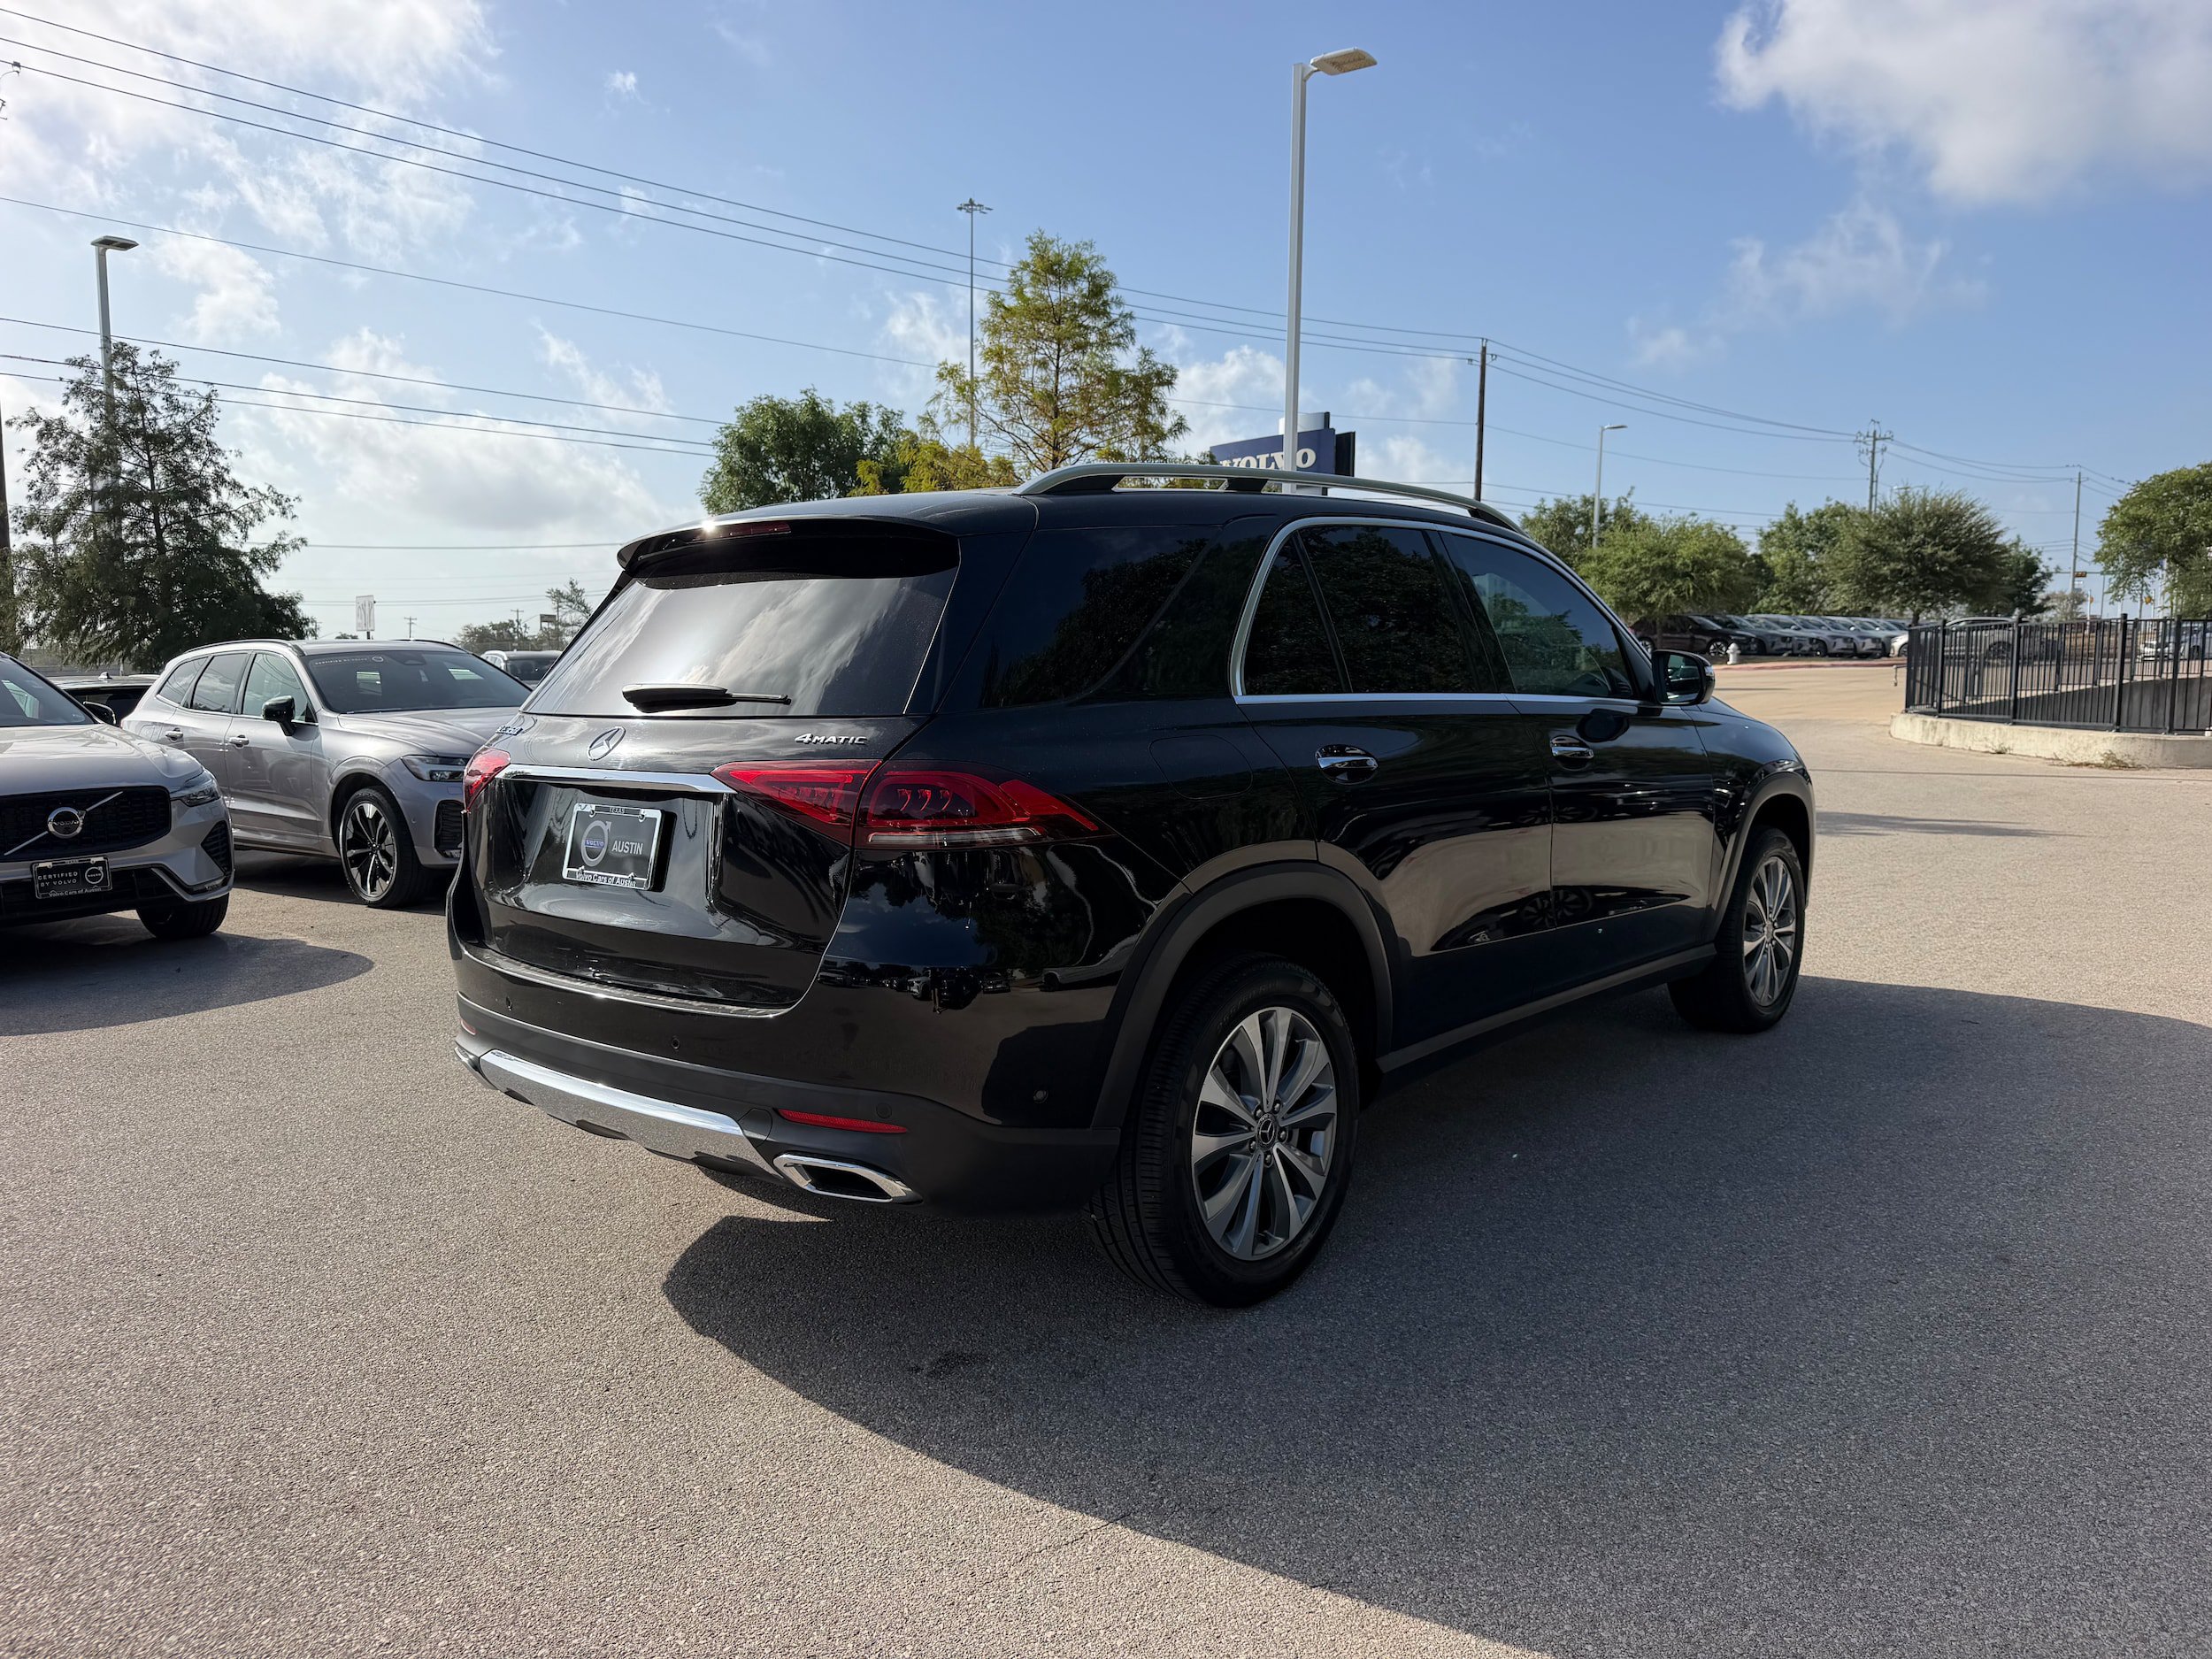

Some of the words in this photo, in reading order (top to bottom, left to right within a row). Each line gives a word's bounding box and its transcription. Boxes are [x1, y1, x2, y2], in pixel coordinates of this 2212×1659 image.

[795, 733, 867, 745] 4MATIC
[611, 841, 644, 855] AUSTIN
[37, 871, 78, 880] CERTIFIED
[576, 872, 592, 880] Volvo
[592, 873, 607, 883] Cars
[615, 876, 637, 887] Austin
